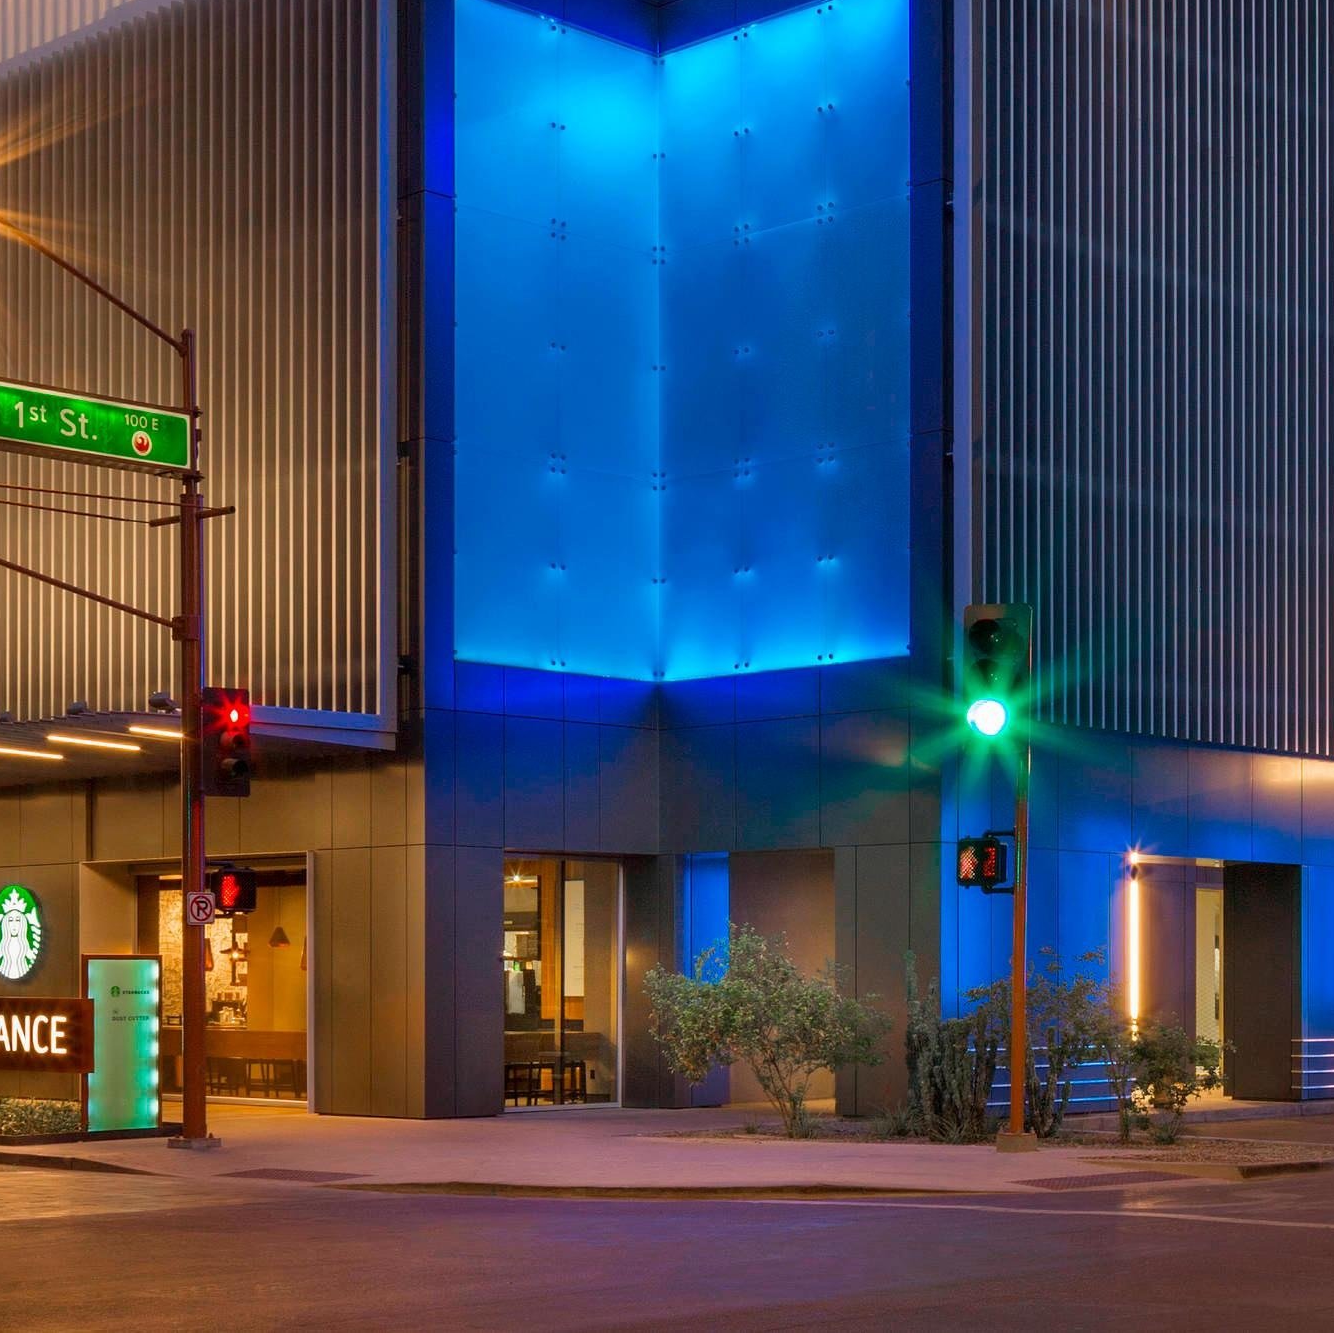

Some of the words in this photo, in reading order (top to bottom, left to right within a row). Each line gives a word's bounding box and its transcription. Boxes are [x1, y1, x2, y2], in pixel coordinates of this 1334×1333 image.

[14, 401, 47, 428] 1st
[60, 409, 98, 441] St.
[124, 413, 148, 429] 100
[152, 417, 159, 431] E
